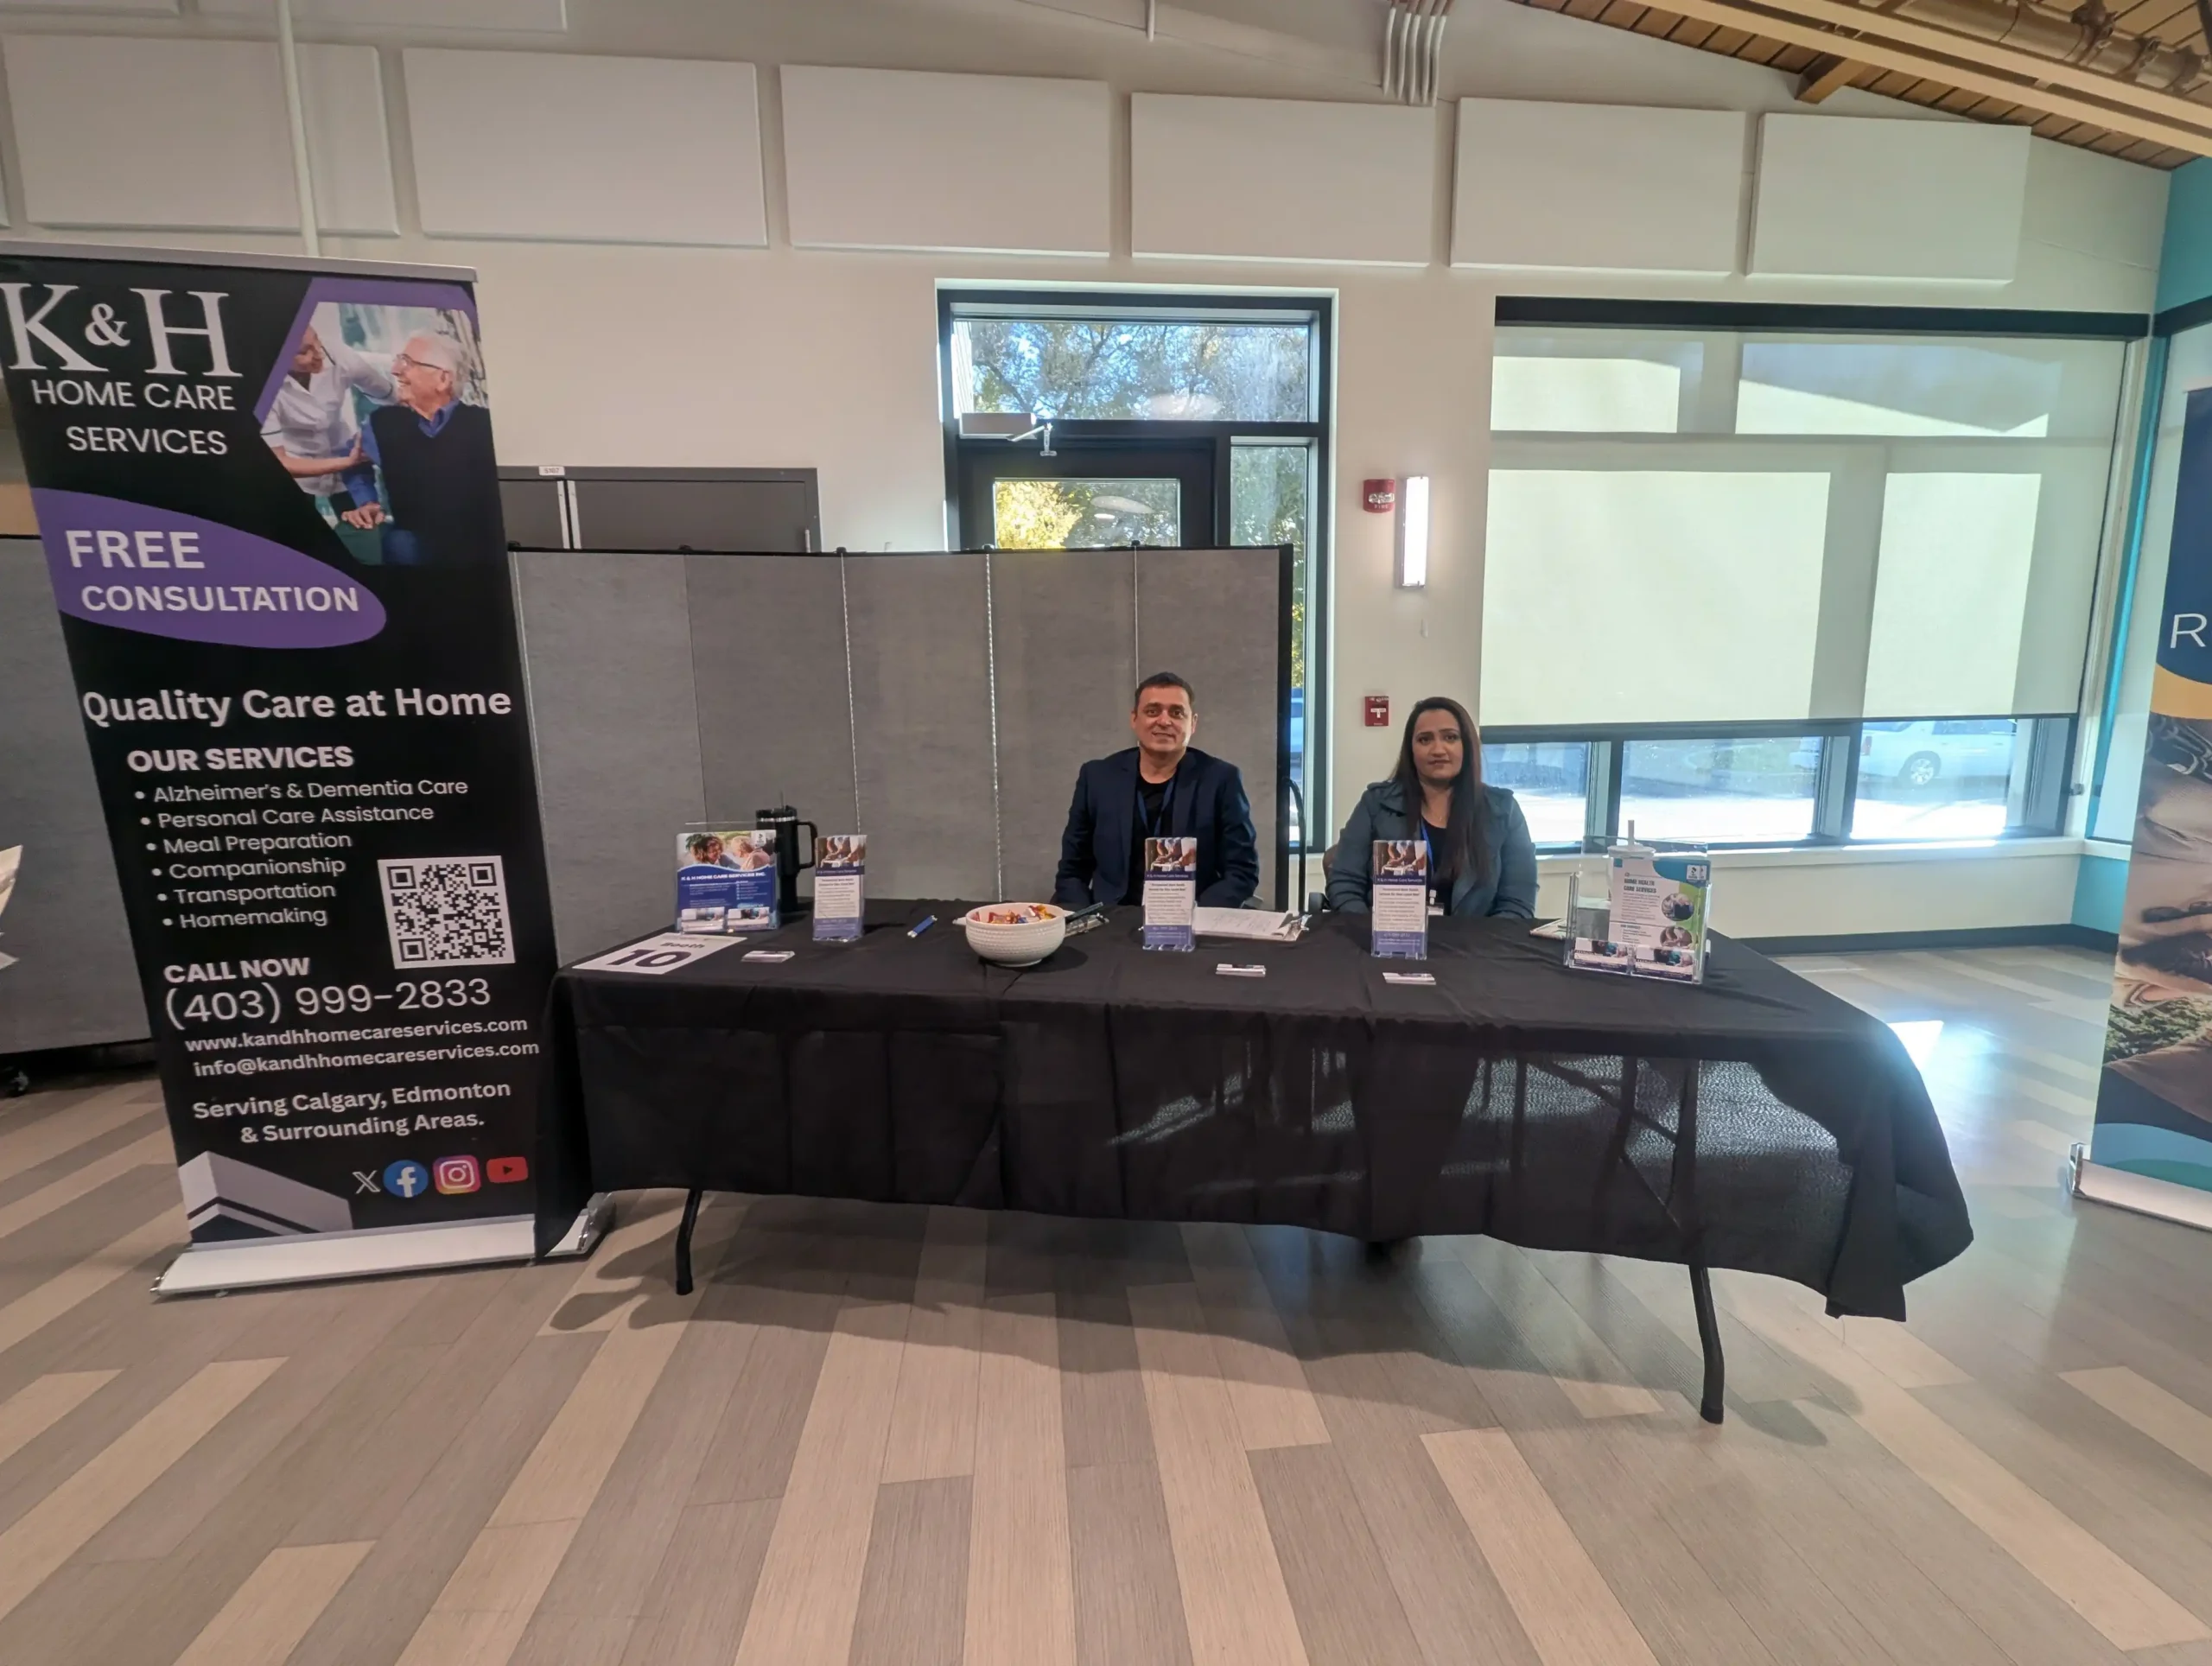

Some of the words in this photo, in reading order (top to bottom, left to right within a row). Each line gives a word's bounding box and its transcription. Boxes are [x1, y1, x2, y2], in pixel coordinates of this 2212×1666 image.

[31, 378, 135, 408] HOME
[144, 382, 236, 410] CARE
[67, 426, 227, 455] SERVICES
[66, 530, 205, 569] FREE
[81, 585, 359, 612] CONSULTATION
[82, 689, 232, 728] Quality
[243, 689, 335, 720] Care
[346, 690, 387, 717] at
[394, 688, 512, 716] Home
[127, 749, 200, 773] OUR
[205, 746, 354, 771] SERVICES
[153, 783, 282, 804] Alzheimer's
[287, 783, 303, 798] &
[308, 779, 413, 798] Dementia
[417, 779, 468, 795] Care
[157, 809, 257, 829] Personal
[263, 810, 315, 824] Care
[321, 805, 435, 823] Assistance
[163, 836, 221, 855] Meal
[226, 833, 353, 855] Preparation
[168, 857, 346, 881] Companionship
[174, 884, 336, 906] Transportation
[180, 908, 328, 930] Homemaking
[163, 959, 237, 983] CALL
[240, 957, 309, 979] NOW
[607, 949, 692, 968] 10
[165, 982, 281, 1030] (403)
[296, 977, 491, 1016] 999-2833
[184, 1020, 529, 1052] www.kandhhomecareservices.com
[194, 1042, 539, 1078] info@kandhhomecareservices.com
[193, 1097, 289, 1120] Serving
[292, 1091, 387, 1113] Calgary,
[391, 1083, 512, 1105] Edmonton
[240, 1127, 259, 1143] &
[262, 1112, 410, 1141] Surrounding
[414, 1115, 485, 1131] Areas.
